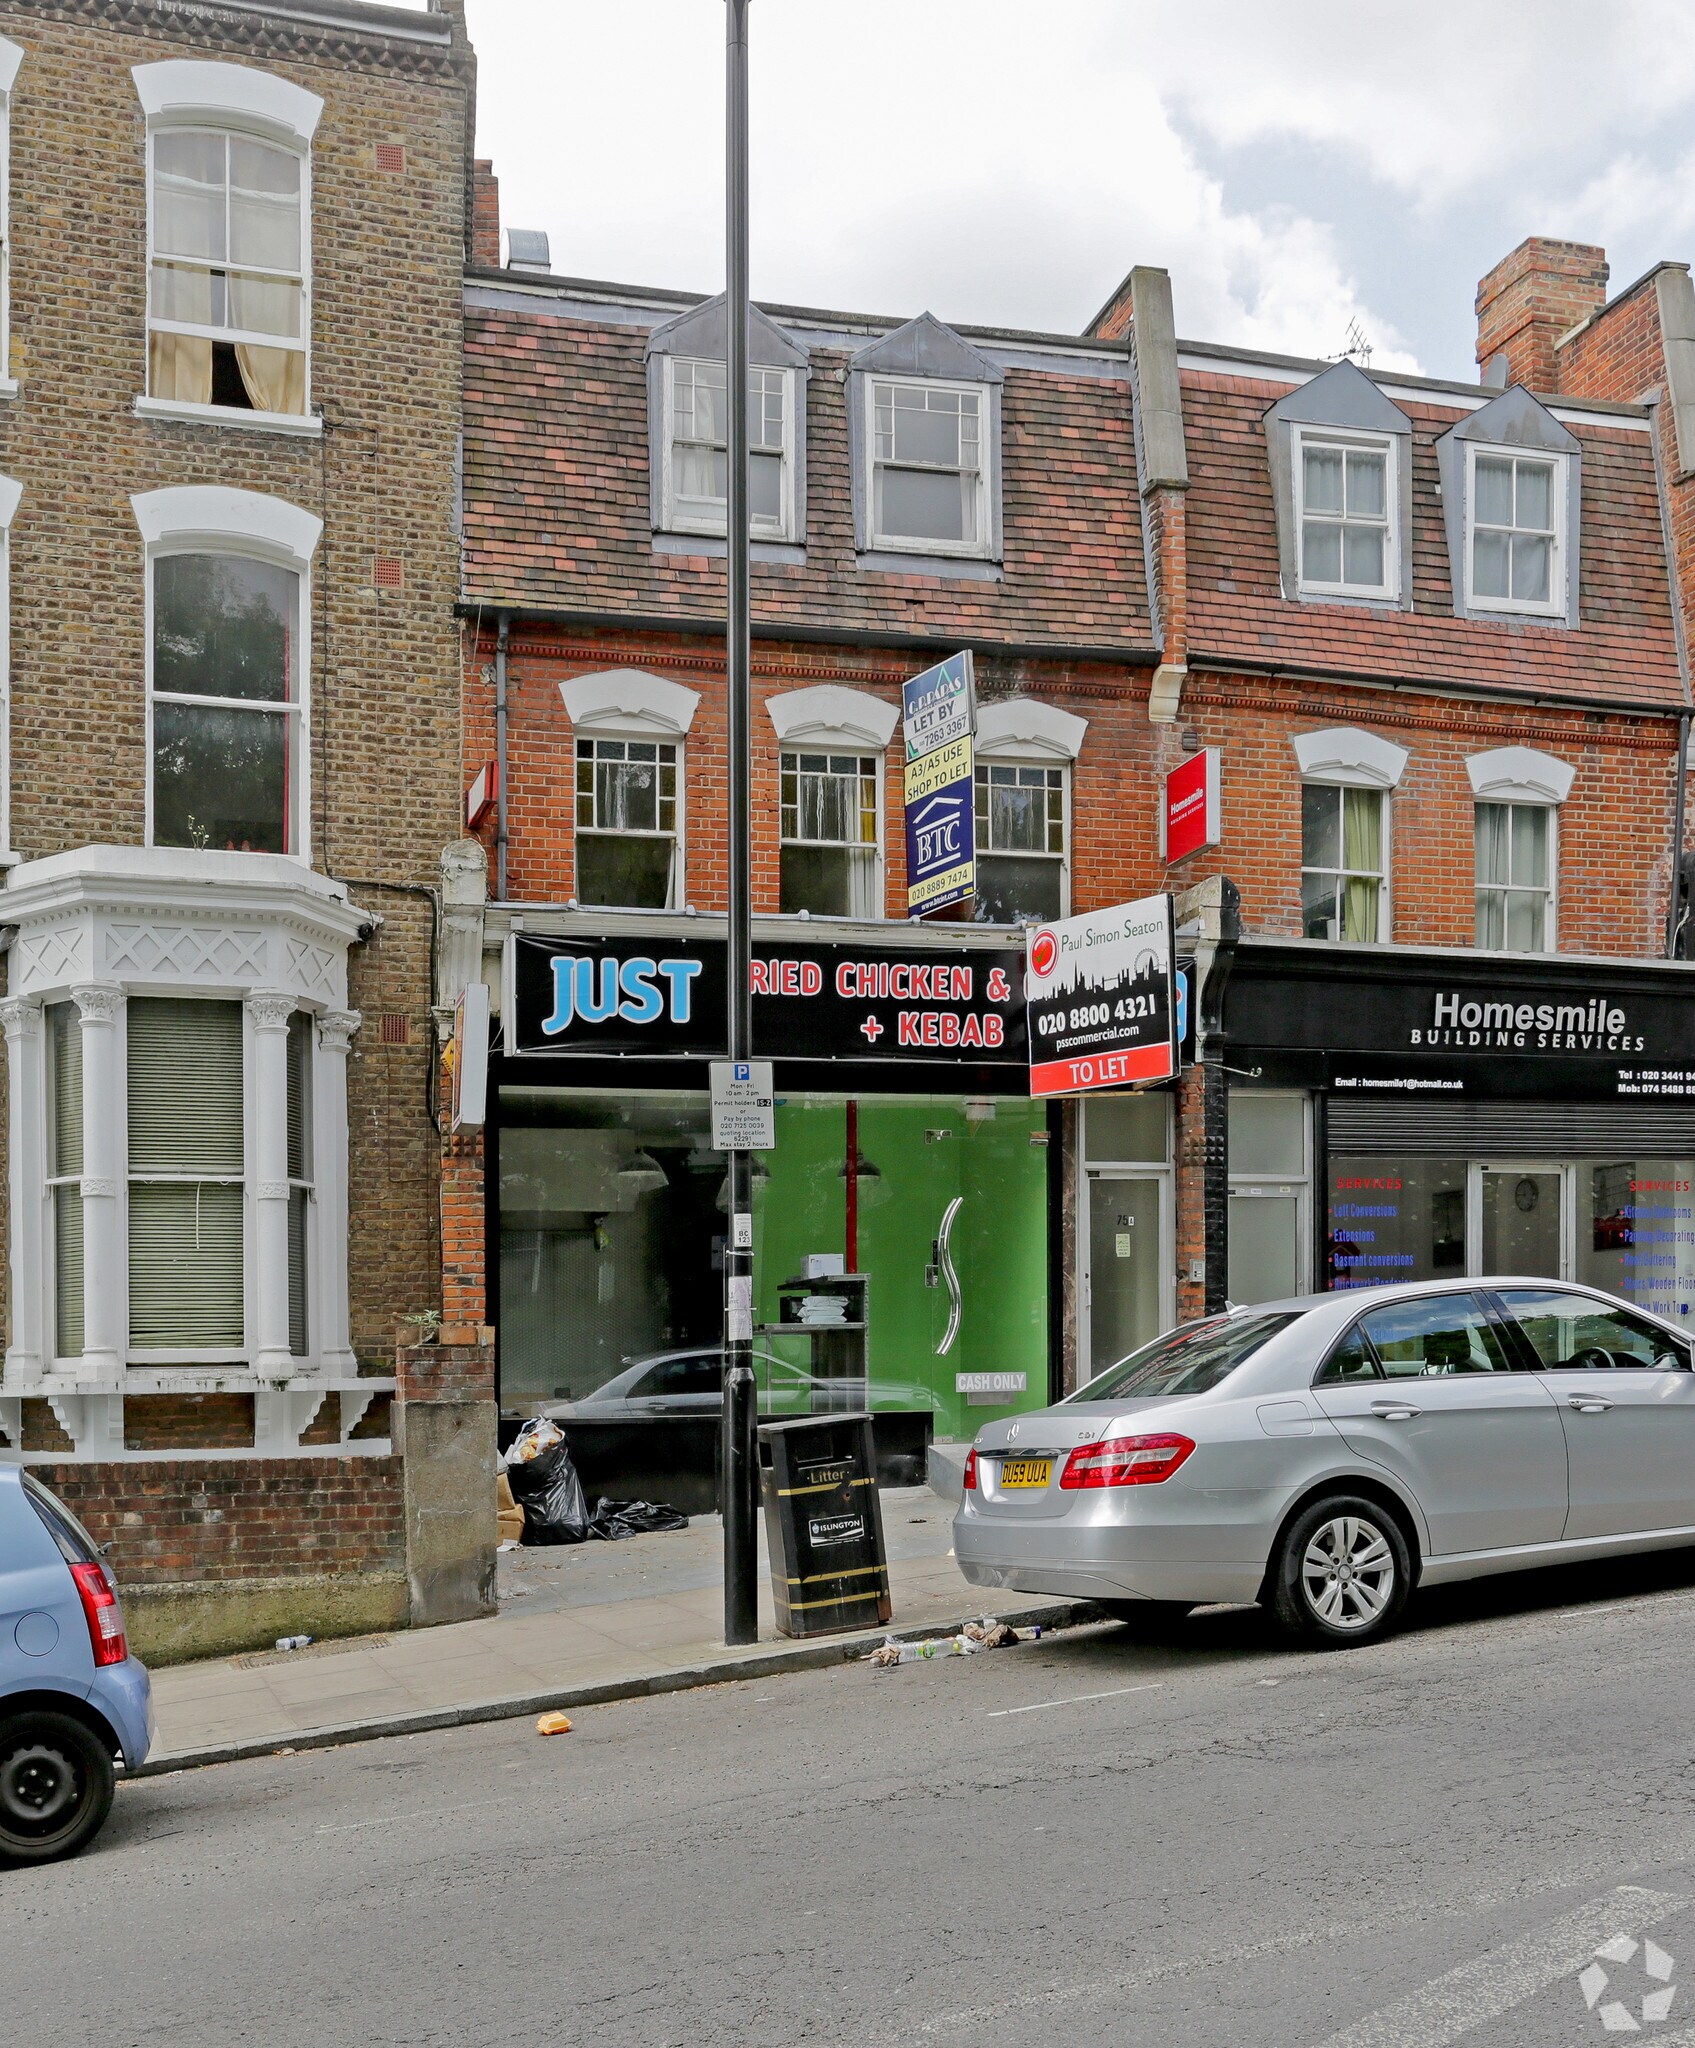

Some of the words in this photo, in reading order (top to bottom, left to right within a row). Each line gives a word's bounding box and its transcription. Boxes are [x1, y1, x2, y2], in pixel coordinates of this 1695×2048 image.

[914, 711, 934, 733] LET
[939, 700, 954, 720] BY
[925, 728, 944, 746] 7263
[947, 716, 966, 735] 3367
[911, 755, 940, 780] A3/A5
[944, 744, 963, 762] USE
[908, 779, 931, 801] SHOP
[934, 772, 947, 787] TO
[950, 762, 967, 777] LET
[917, 820, 960, 865] BTC
[912, 887, 925, 901] 020
[926, 878, 945, 894] 8889
[947, 869, 967, 885] 7474
[1061, 934, 1082, 953] Paul
[1086, 928, 1119, 947] Simon
[1124, 919, 1163, 938] Seaton
[750, 958, 822, 997] RIED
[835, 962, 972, 1001] CHICKEN
[986, 967, 1011, 1002] &
[542, 956, 702, 1035] JUST
[1038, 1012, 1065, 1036] 020
[1070, 1003, 1109, 1030] 8800
[1114, 994, 1155, 1021] 4321
[1434, 993, 1626, 1034] Homesmile
[898, 1011, 1004, 1048] KEBAB
[1056, 1025, 1139, 1052] psscommercial.com
[1410, 1029, 1526, 1048] BUILDING
[1537, 1033, 1644, 1051] SERVICES
[737, 1065, 748, 1079] P
[1069, 1062, 1093, 1084] TO
[1099, 1055, 1128, 1080] LET
[1618, 1070, 1633, 1080] Tel
[1642, 1071, 1660, 1080] 020
[1661, 1071, 1683, 1081] 3441
[1335, 1078, 1357, 1087] Email
[1617, 1084, 1641, 1093] Mob:
[1642, 1084, 1660, 1094] 074
[1336, 1177, 1403, 1190] SERVICES
[1629, 1181, 1690, 1192] SERVICES
[1333, 1204, 1349, 1217] Loft
[1350, 1203, 1398, 1217] Conversions
[1334, 1228, 1376, 1242] Extensions
[1334, 1253, 1367, 1267] Basment
[1368, 1254, 1414, 1267] conversions
[1653, 1301, 1671, 1314] Work
[958, 1375, 990, 1390] CASH
[993, 1374, 1025, 1390] ONLY
[811, 1470, 845, 1483] Litter
[1002, 1464, 1025, 1483] DU59
[1026, 1463, 1047, 1482] UUA
[820, 1520, 860, 1532] ISLINGTON
